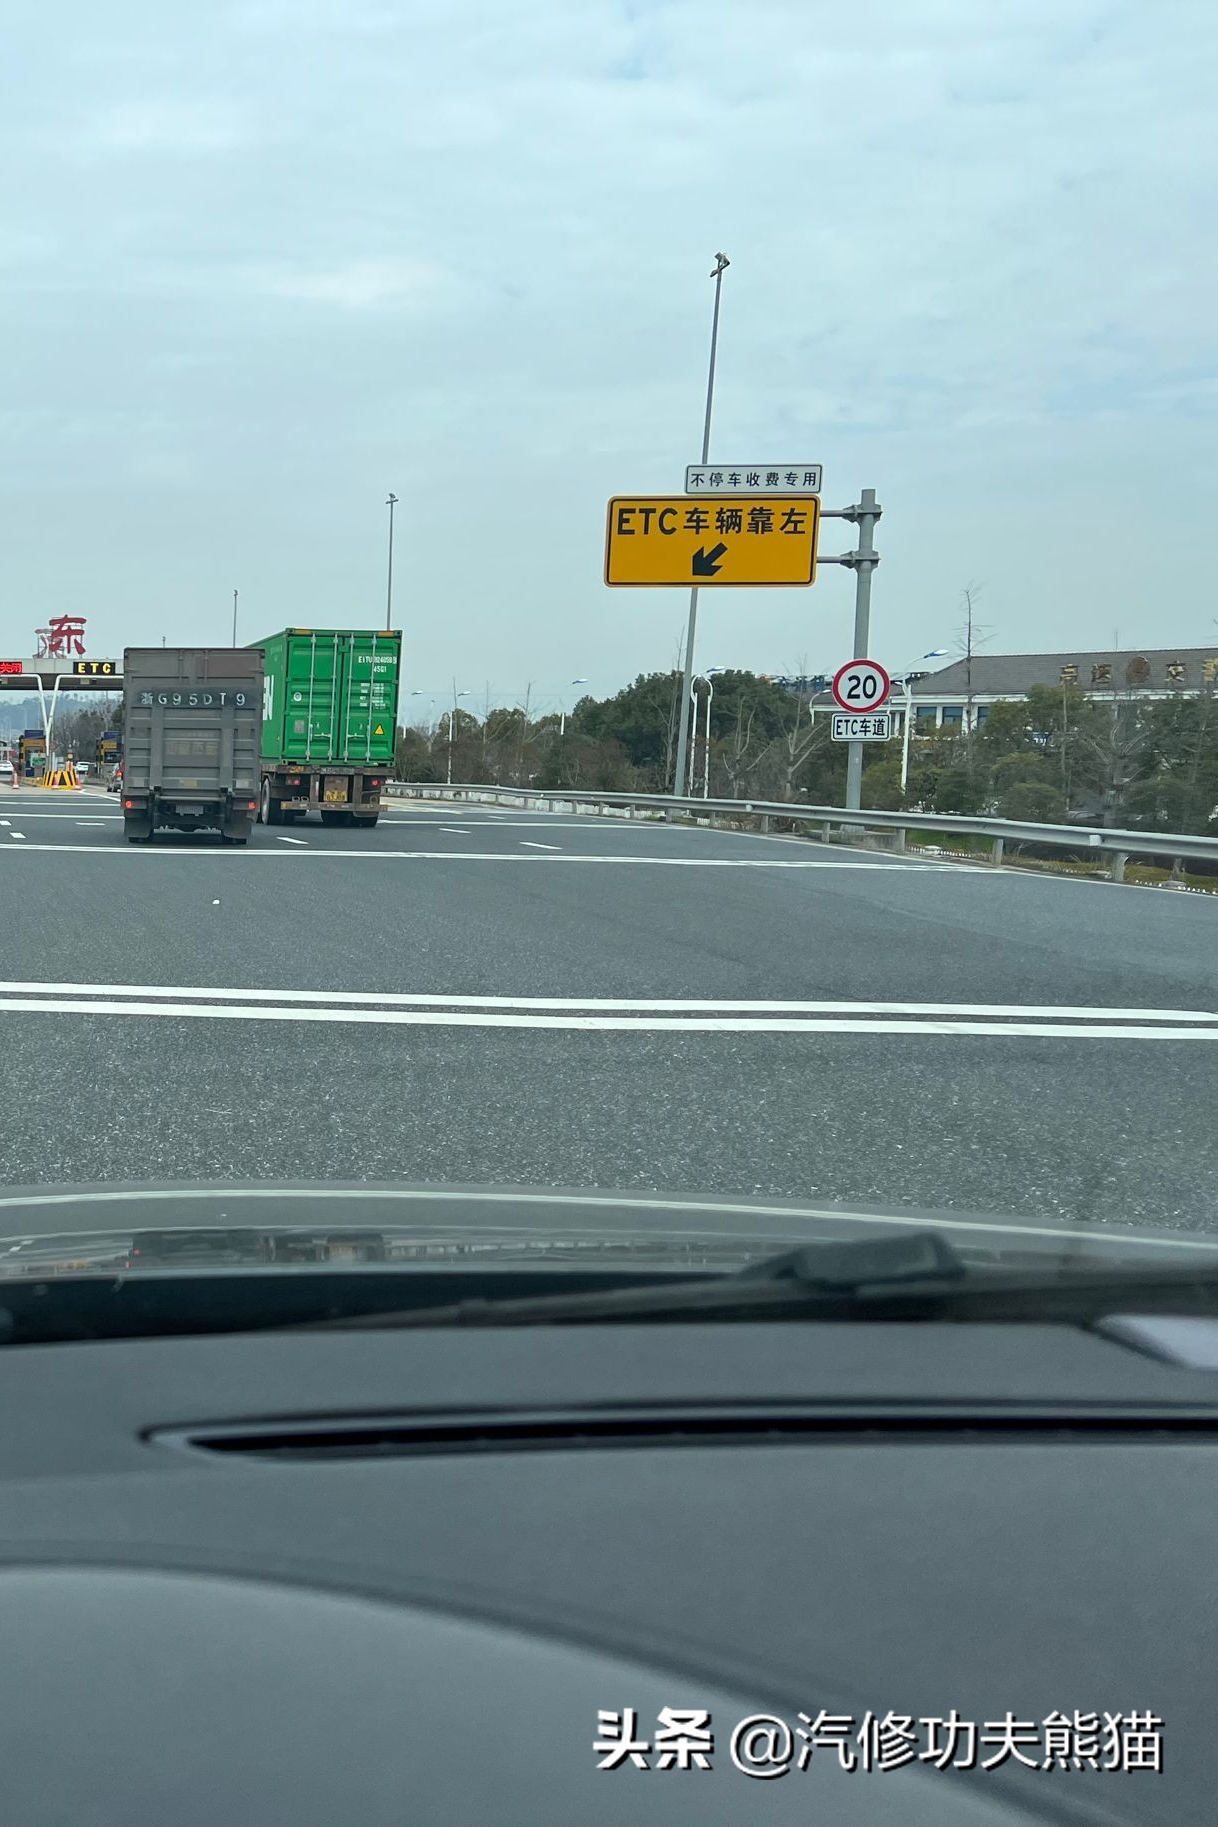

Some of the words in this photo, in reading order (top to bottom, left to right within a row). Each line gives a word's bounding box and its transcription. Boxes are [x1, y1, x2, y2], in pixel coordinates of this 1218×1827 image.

[691, 472, 817, 488] 不停车收费专用
[617, 507, 807, 535] ETC车辆靠左
[78, 663, 111, 673] ETC
[847, 675, 877, 699] 20
[836, 719, 886, 736] ETC车道
